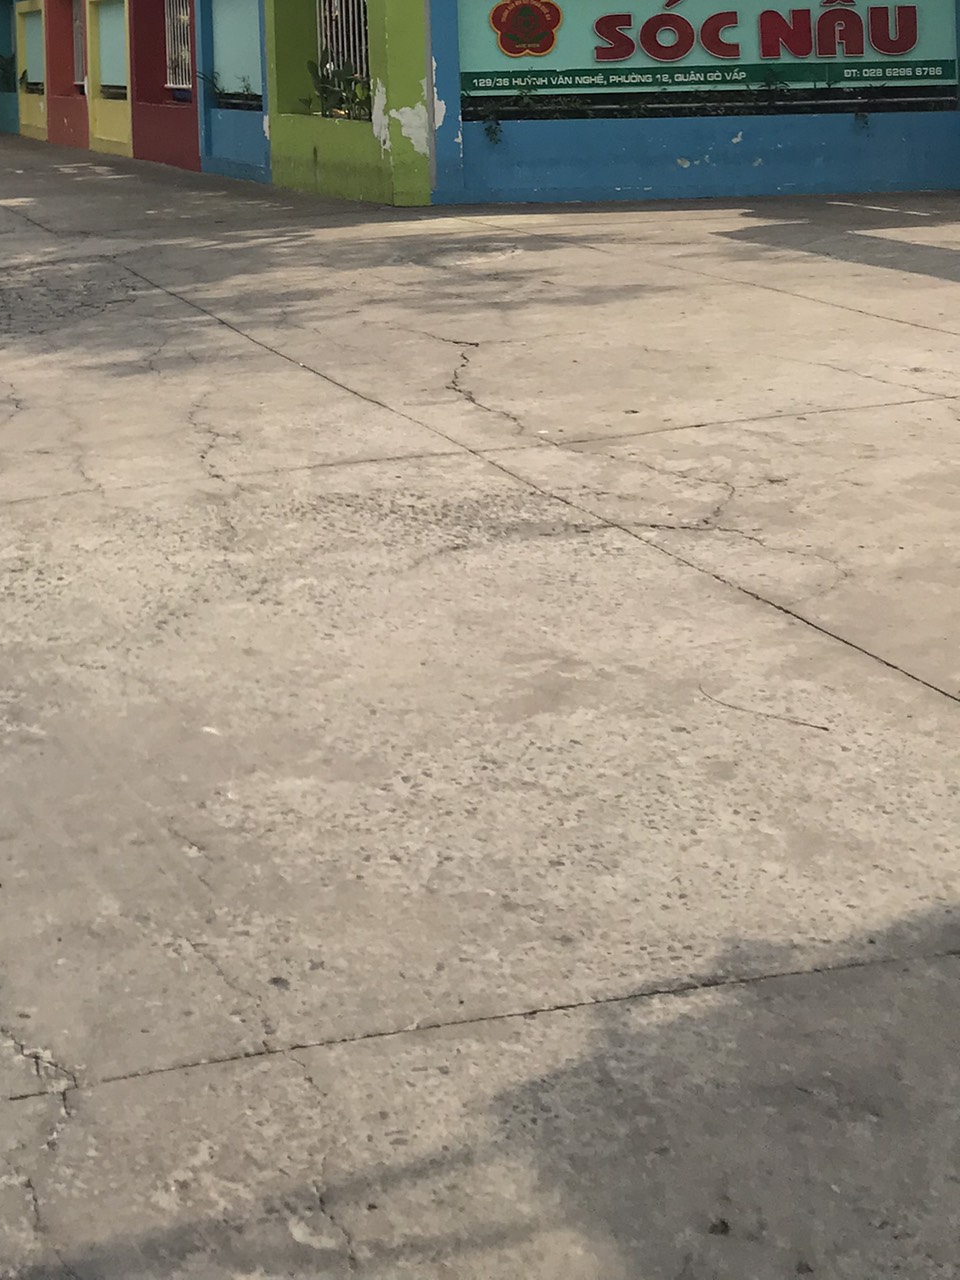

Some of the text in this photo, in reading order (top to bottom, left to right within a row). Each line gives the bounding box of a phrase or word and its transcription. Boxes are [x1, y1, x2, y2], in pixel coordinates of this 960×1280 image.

[472, 68, 746, 87] 129/36 HUỲNH VĂN NGHỆ, PHƯỜNG 12, QUẬN GÒ VẤP
[844, 69, 860, 78] ĐT:
[862, 68, 883, 77] 028
